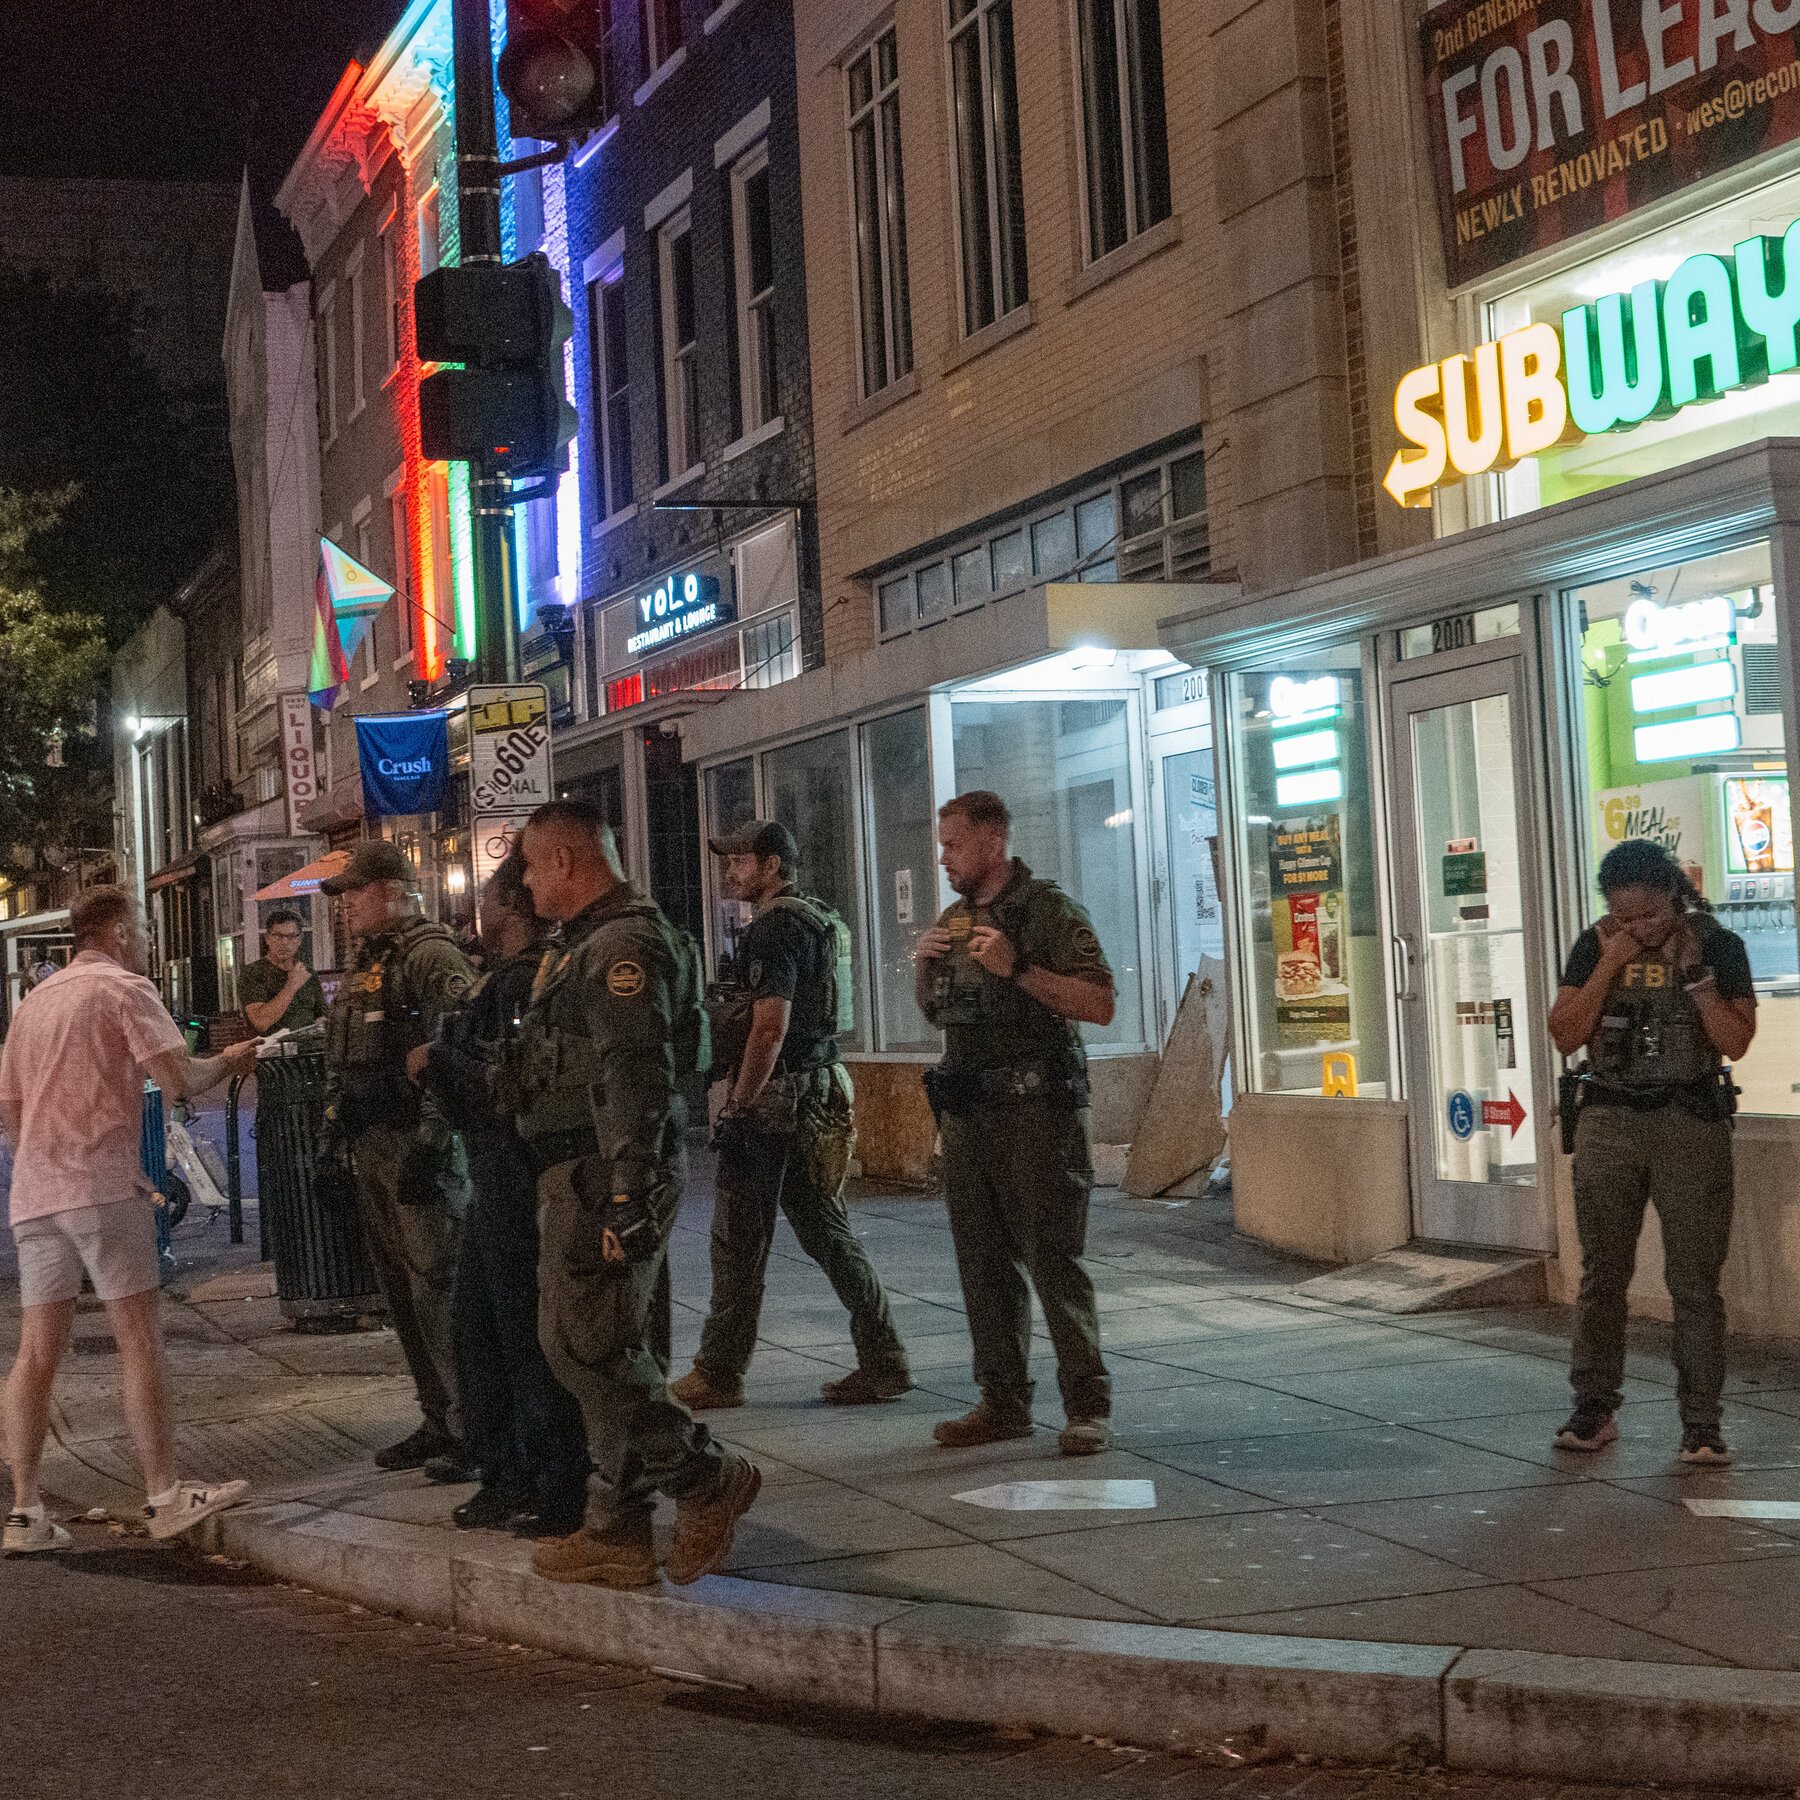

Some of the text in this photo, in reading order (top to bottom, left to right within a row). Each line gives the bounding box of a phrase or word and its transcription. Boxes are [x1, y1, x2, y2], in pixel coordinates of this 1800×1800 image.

[1466, 0, 1541, 42] GENER
[1442, 18, 1584, 194] FOR
[1455, 184, 1524, 246] NEWLY
[1531, 116, 1669, 210] RENOVATED
[1383, 217, 1800, 508] SUBWAY
[639, 573, 699, 622] YOLO
[627, 603, 717, 654] RESTAURANT & LOUNGE
[1433, 615, 1474, 653] 2001
[378, 756, 432, 775] Crush
[1623, 806, 1669, 840] MEAL
